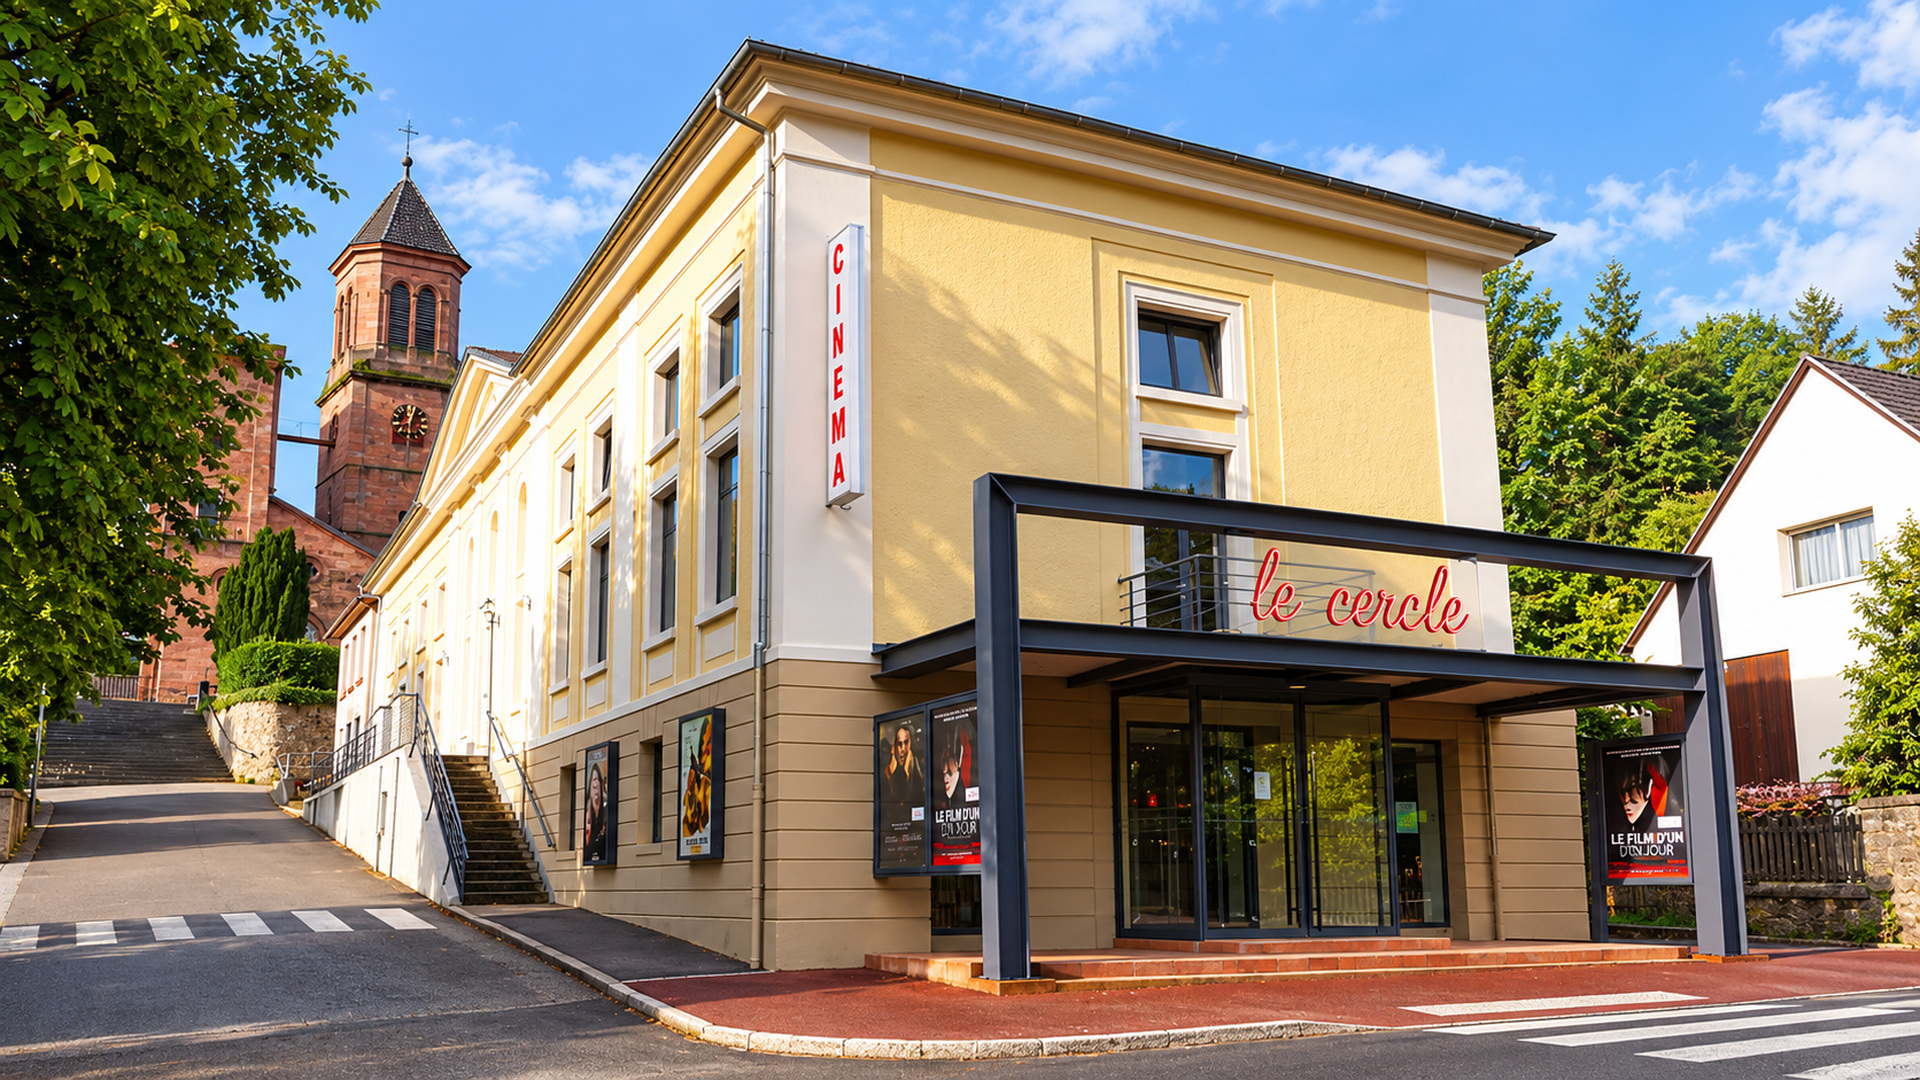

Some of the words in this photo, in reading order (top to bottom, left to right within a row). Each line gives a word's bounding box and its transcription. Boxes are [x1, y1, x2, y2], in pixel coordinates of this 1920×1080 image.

[831, 243, 846, 488] CINEMA
[1250, 547, 1304, 622] le
[1327, 565, 1469, 634] cercle
[935, 810, 945, 823] LE
[1611, 833, 1625, 845] LE
[1627, 832, 1654, 845] FILM
[1656, 831, 1684, 844] D'UN
[1643, 844, 1674, 856] JOUR
